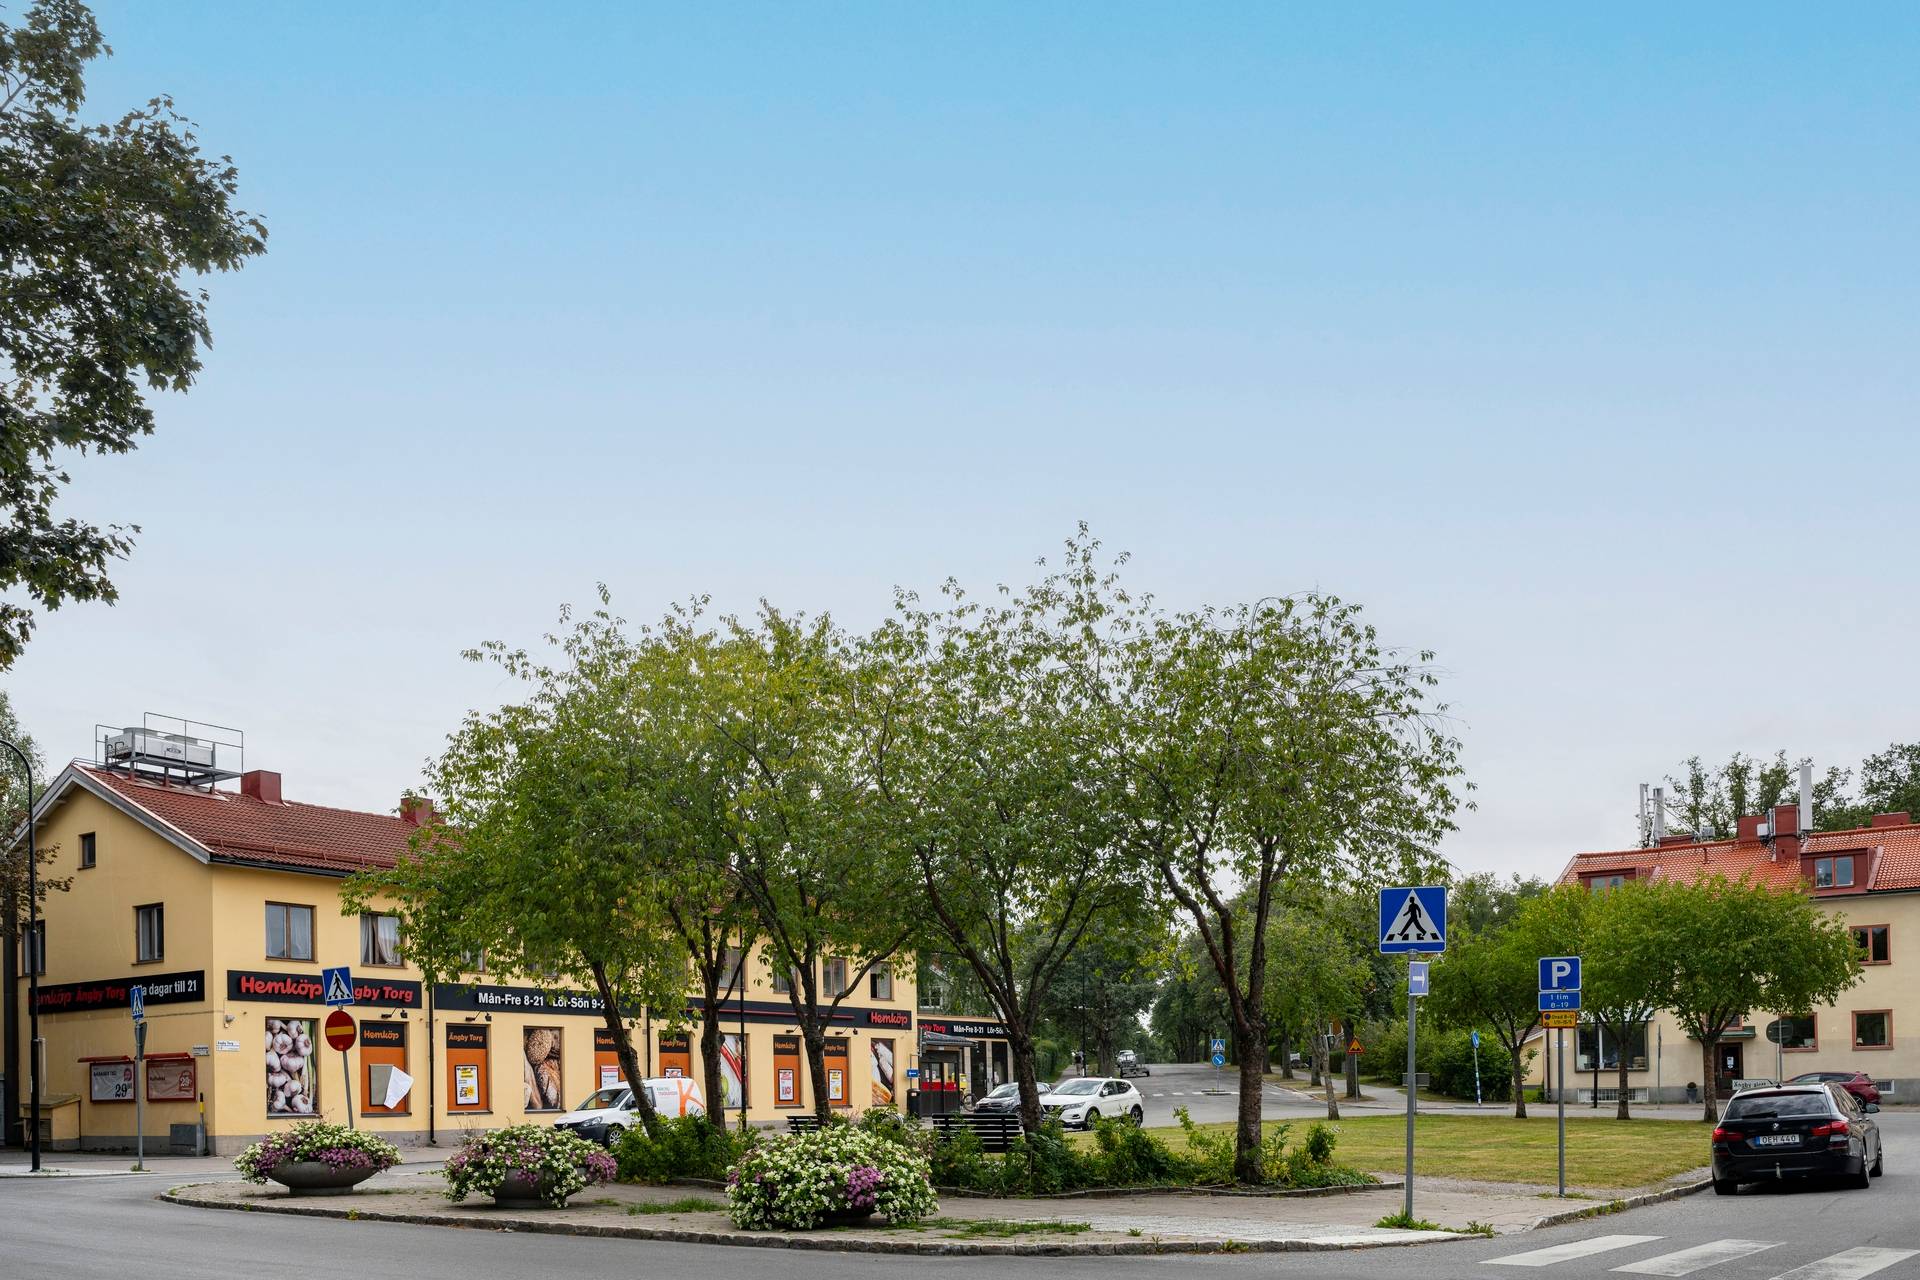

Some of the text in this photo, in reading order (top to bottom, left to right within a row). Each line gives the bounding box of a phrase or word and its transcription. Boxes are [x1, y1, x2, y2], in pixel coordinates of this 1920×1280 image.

[1551, 960, 1571, 988] P
[106, 986, 126, 1001] Torg
[149, 983, 173, 997] dagar
[174, 980, 186, 993] till
[187, 979, 197, 992] 21
[240, 975, 413, 1003] Hemköp gby Torg
[478, 992, 522, 1006] Mån-Fre
[523, 995, 544, 1007] 8-21
[870, 1011, 908, 1027] Hemköp
[363, 1029, 400, 1041] Hemköp
[449, 1031, 484, 1043] Ängby Torg
